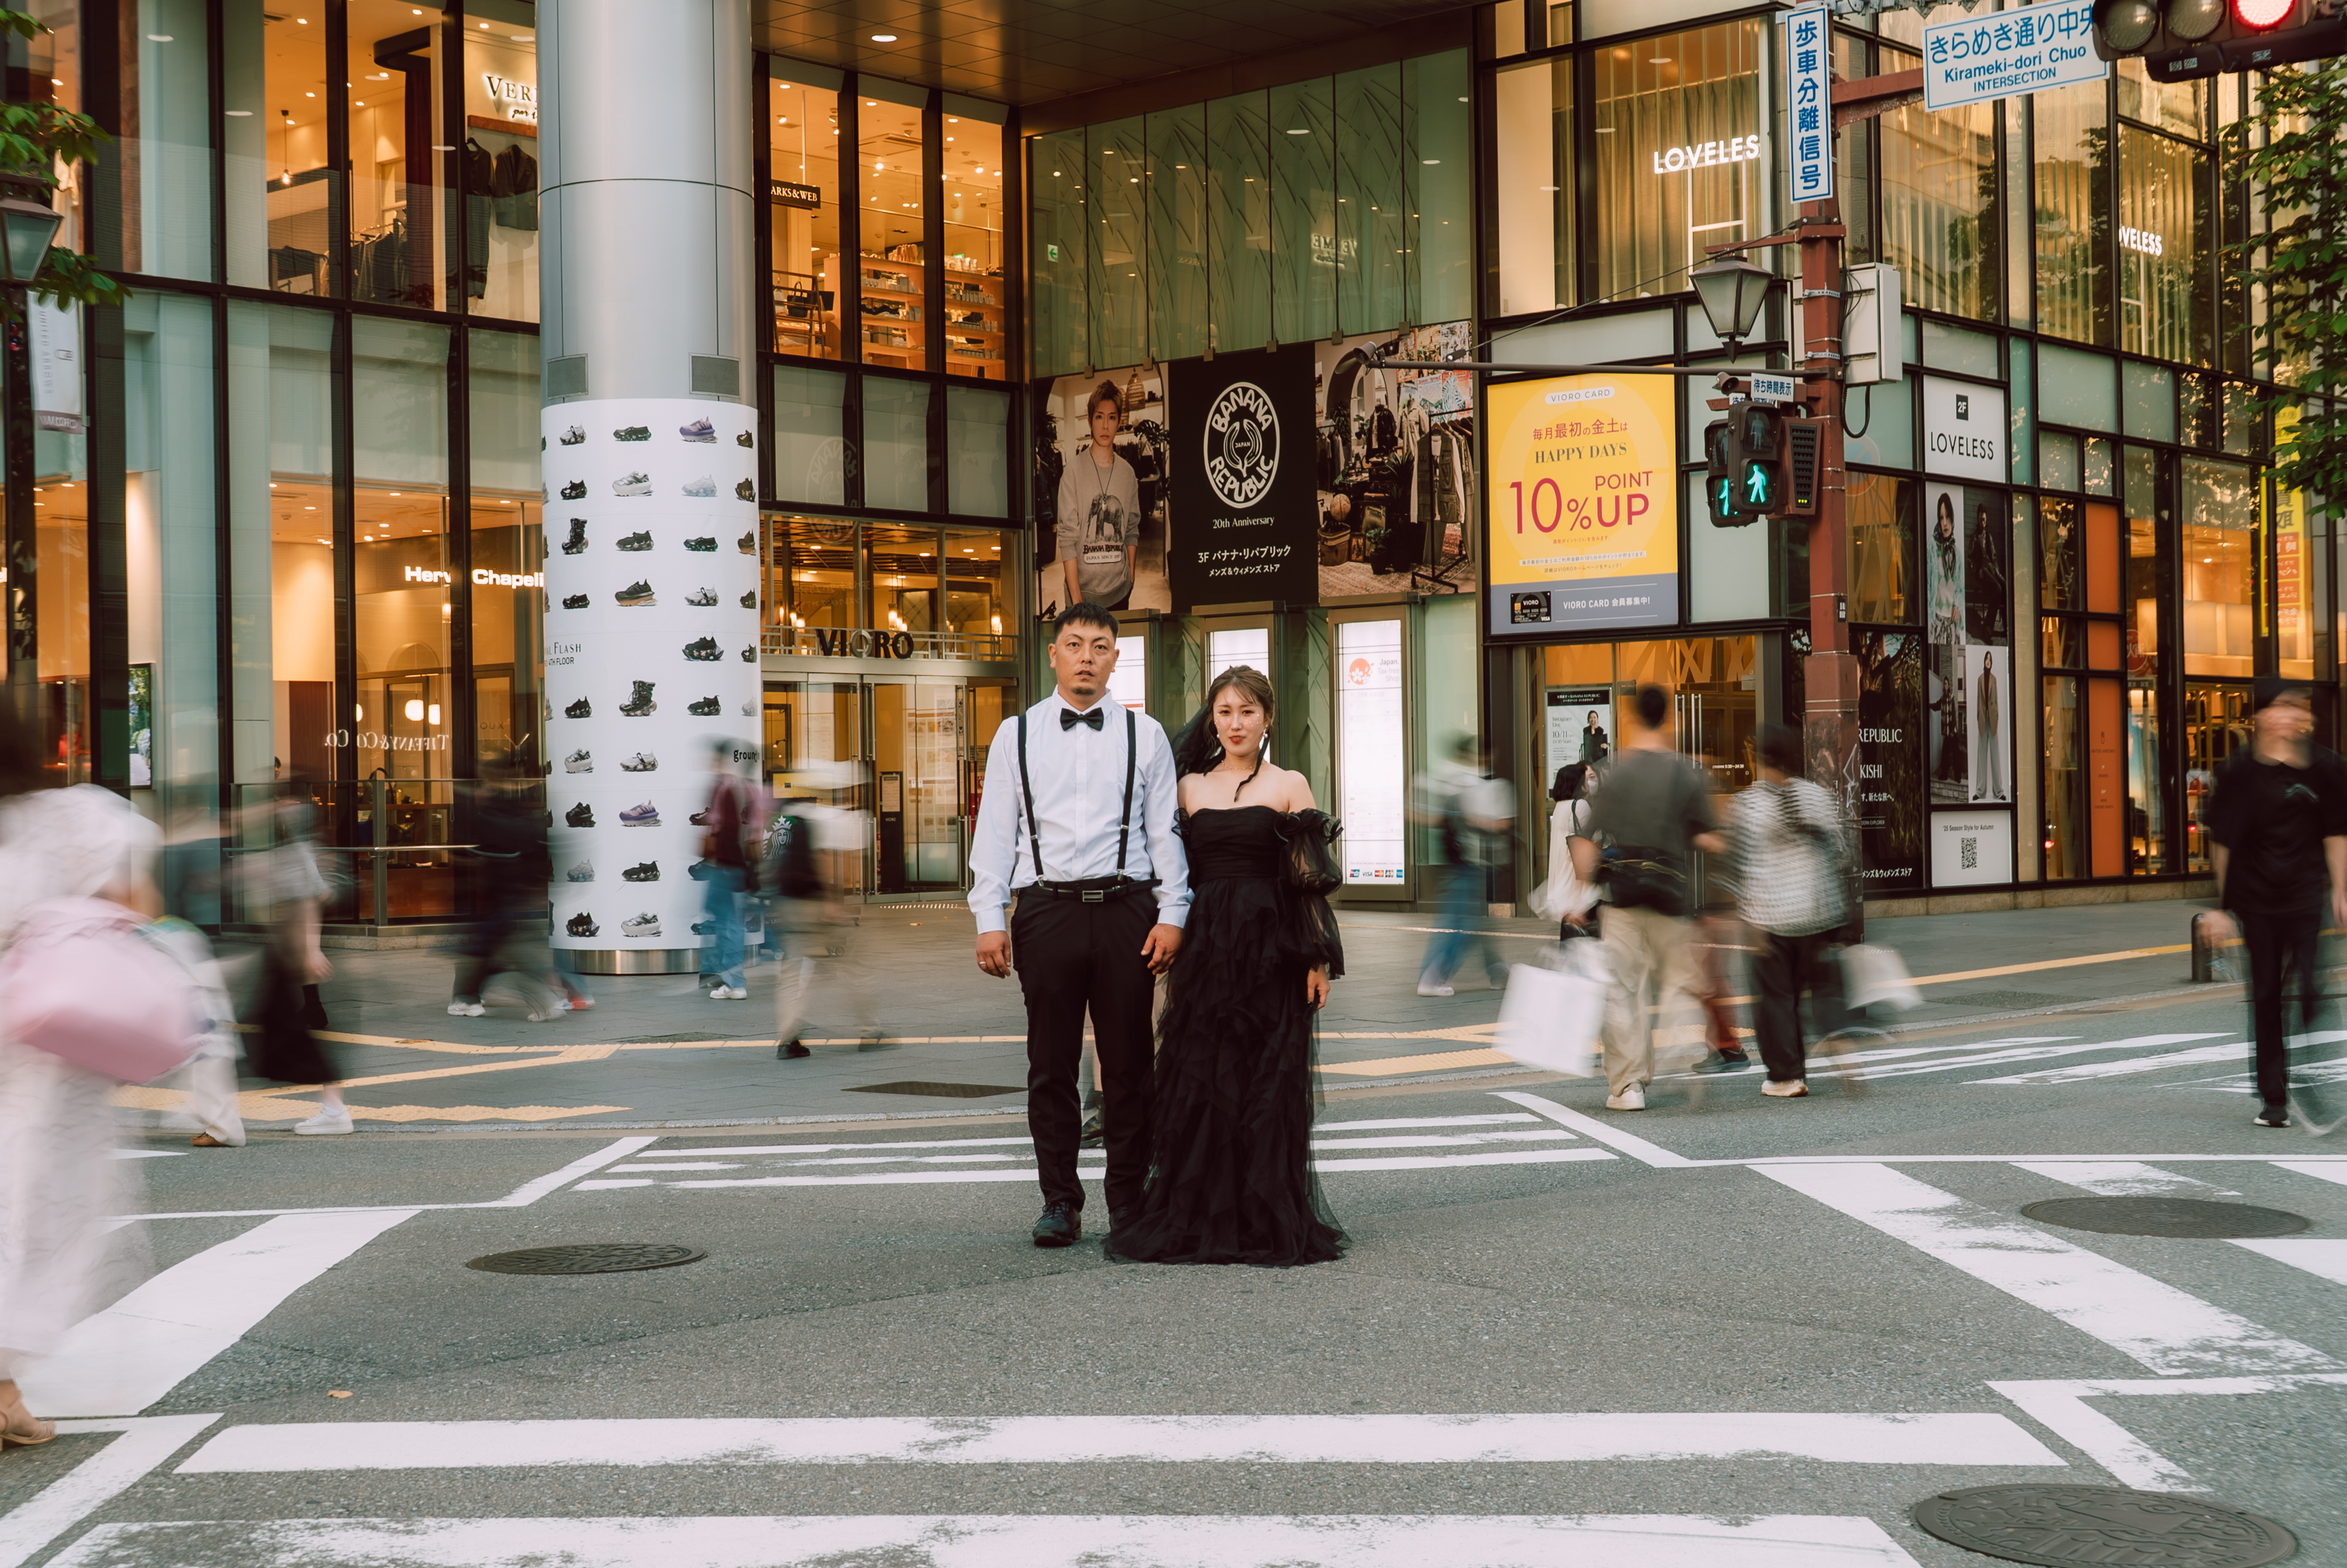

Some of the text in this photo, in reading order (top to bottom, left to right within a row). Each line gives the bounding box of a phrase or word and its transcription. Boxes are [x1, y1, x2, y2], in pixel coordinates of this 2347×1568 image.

[1945, 46, 2086, 83] Kirameki-dori Chuo
[486, 76, 537, 103] VER
[1973, 67, 2056, 93] INTERSECTION
[1795, 20, 1821, 190] 歩車分離信号
[1654, 134, 1760, 174] LOVELES
[771, 186, 818, 202] ARKS&WEB
[1551, 389, 1610, 402] VIORO CARD
[1754, 378, 1792, 396] 待ち時間表示
[1211, 387, 1273, 434] BANANA
[1958, 401, 1967, 413] 2F
[1533, 417, 1628, 441] 毎月最初の金土は
[1535, 442, 1627, 464] HAPPY DAYS
[1931, 432, 1994, 460] LOVELESS
[1210, 455, 1274, 502] REPUBLIC
[1595, 471, 1653, 490] POINT
[1597, 494, 1649, 527] UP
[1213, 517, 1275, 529] 20th Anniversary
[1198, 545, 1291, 563] 3F バナナ・リパブリック
[405, 566, 544, 589] Herv Chapeli
[1209, 564, 1280, 577] メンズ&ウィメンズ ストア
[1563, 596, 1650, 610] VIORO CARD 会員募集中!
[554, 642, 581, 655] FLASH
[816, 629, 914, 659] VIORO
[556, 657, 574, 666] FLOOR
[1858, 728, 1902, 743] REPUBLIC
[1860, 764, 1882, 778] KISHI
[1862, 867, 1912, 878] メンズ&ウィメンズ ストア
